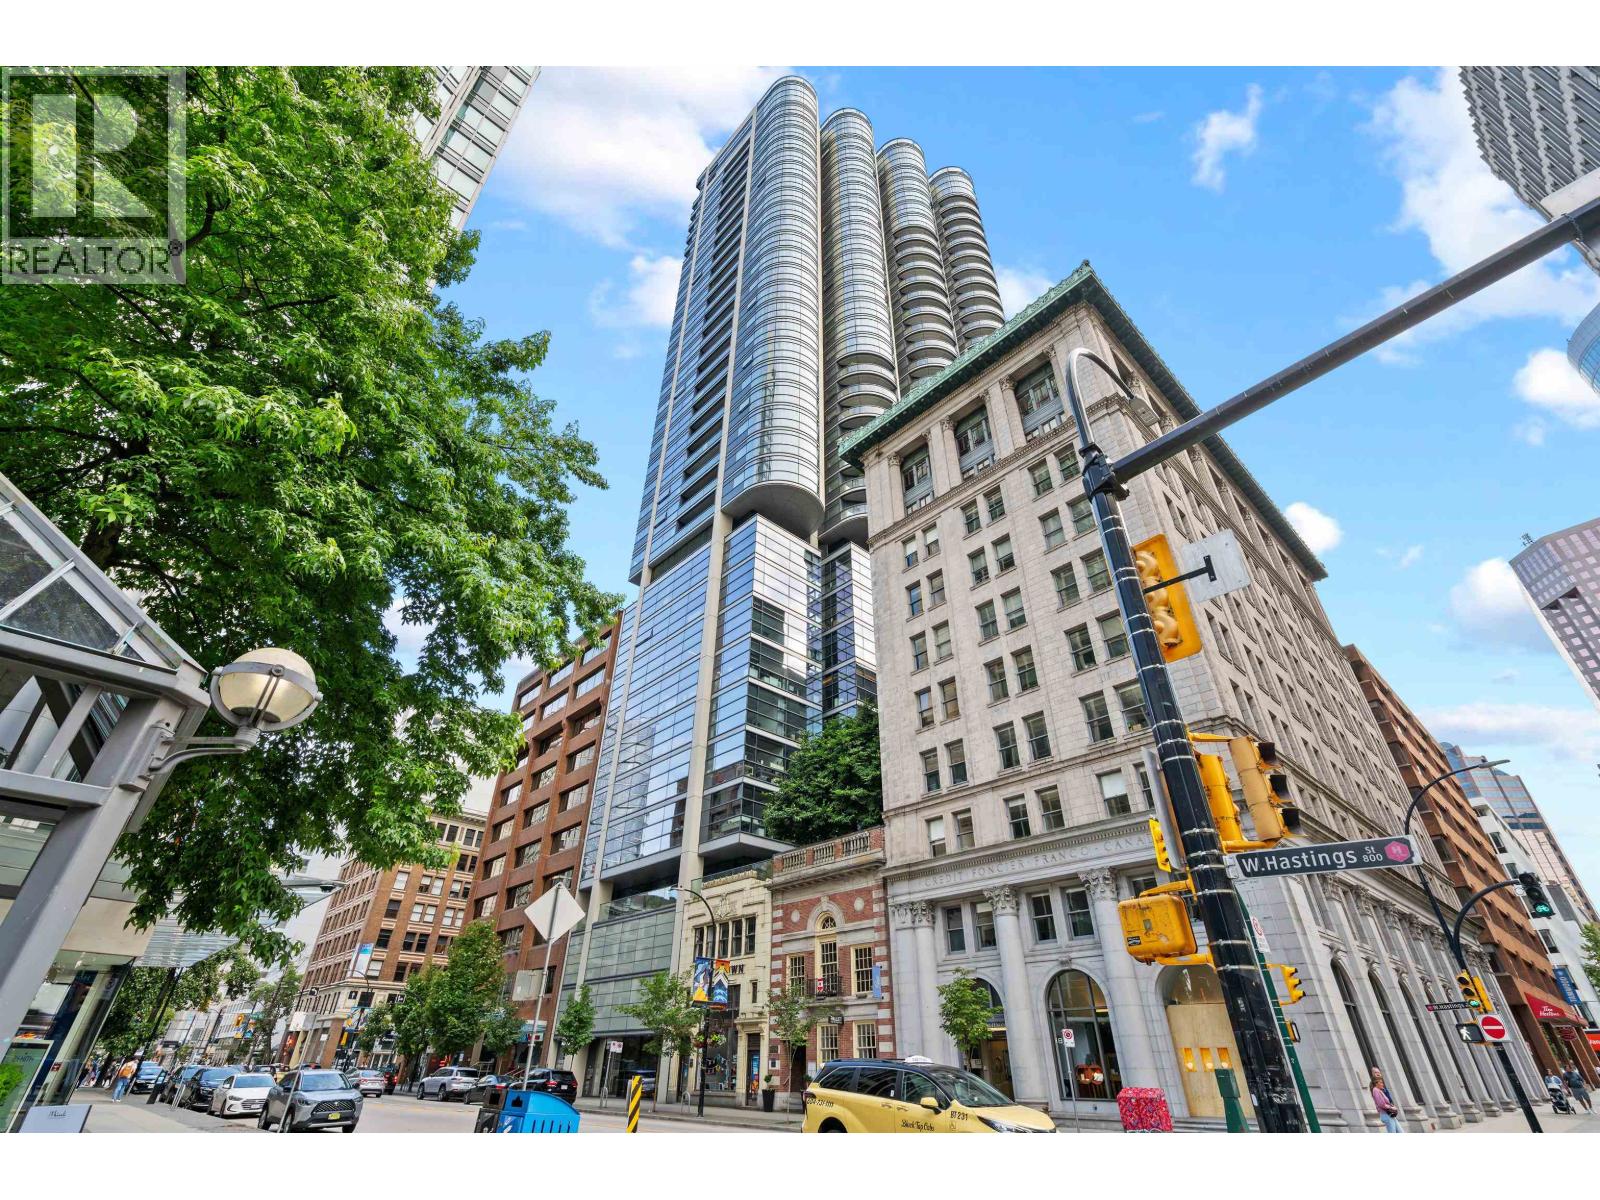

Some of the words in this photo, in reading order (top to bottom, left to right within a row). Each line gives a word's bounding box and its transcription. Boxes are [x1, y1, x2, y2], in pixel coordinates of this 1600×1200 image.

[1364, 845, 1376, 855] St
[1241, 849, 1358, 873] W.Hastings
[1362, 853, 1383, 863] 800
